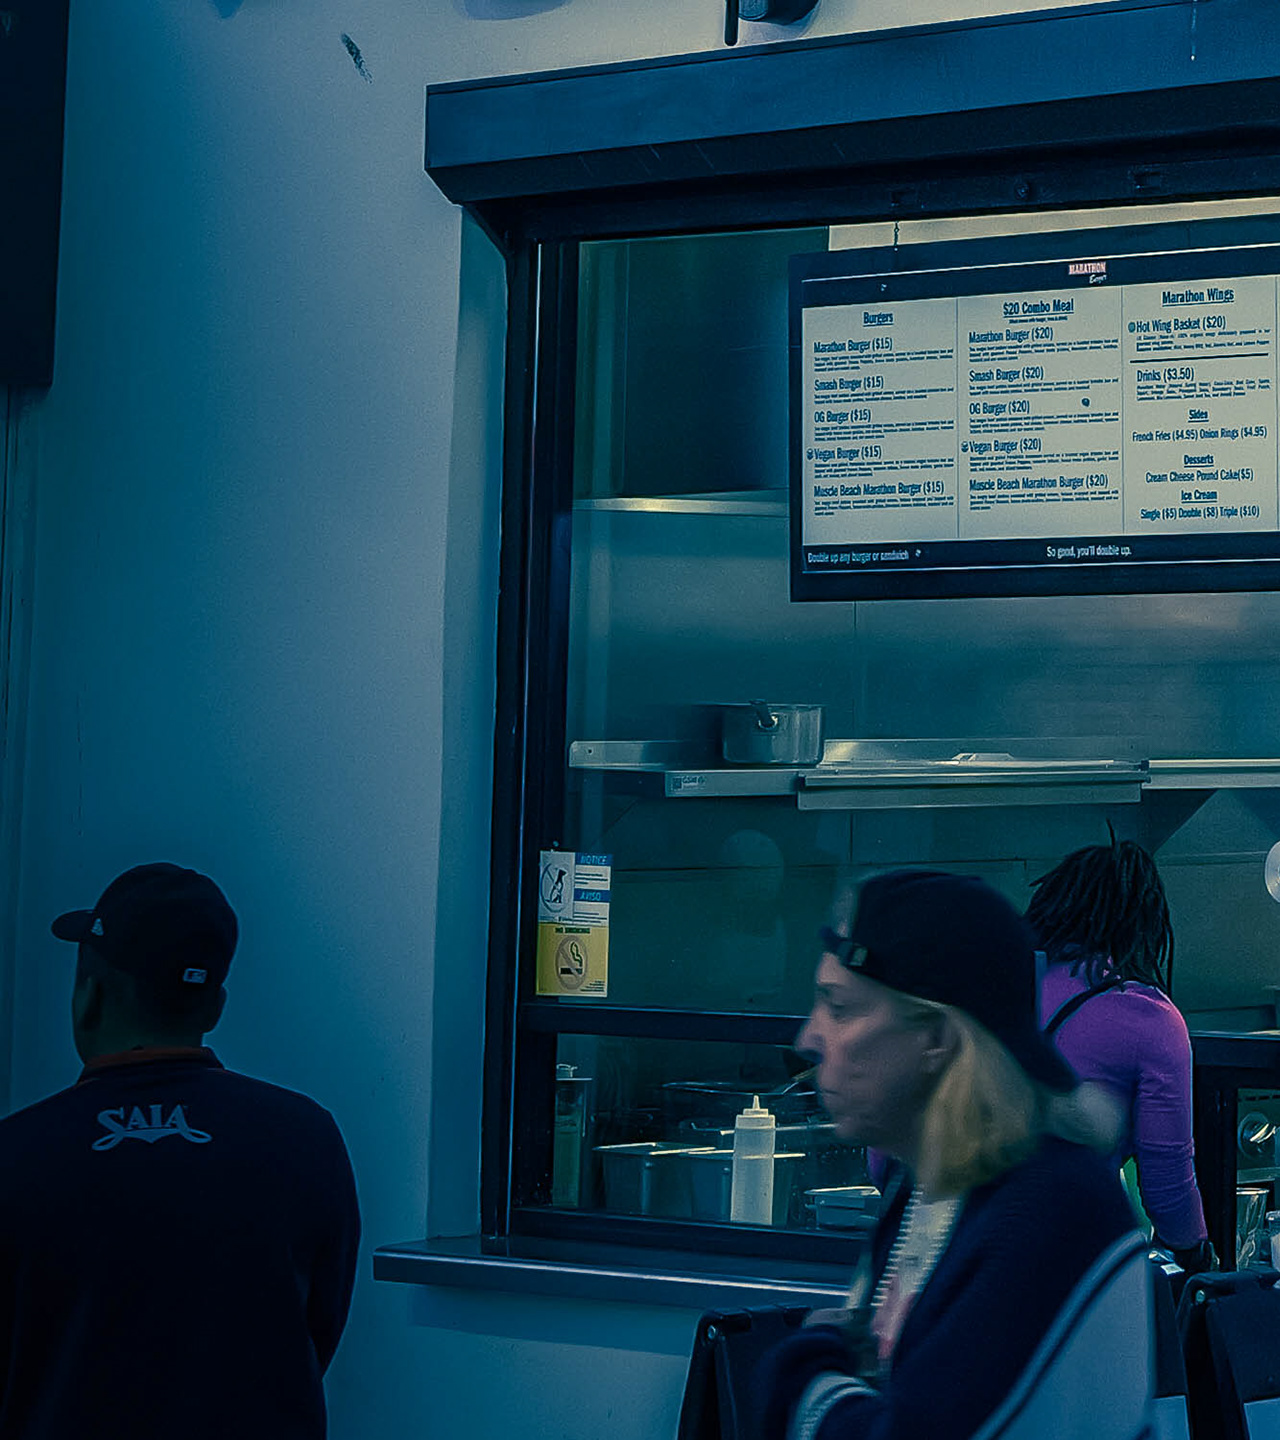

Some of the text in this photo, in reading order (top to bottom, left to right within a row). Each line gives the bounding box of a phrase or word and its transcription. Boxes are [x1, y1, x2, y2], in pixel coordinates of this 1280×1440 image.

[1162, 288, 1234, 303] Marathon Wings
[1003, 298, 1074, 315] $20 Combo Meal
[863, 312, 893, 324] Burgers
[1137, 316, 1226, 333] Hot Wing Basket ($20)
[969, 327, 1053, 343] Marathon Burger ($20)
[814, 337, 893, 353] Marathon Burger ($15)
[969, 367, 1044, 382] Smash Burger ($20)
[1137, 368, 1194, 383] Drinks ($3.50)
[815, 376, 883, 391] Smash Burger ($15)
[970, 400, 1029, 416] OG Burger ($20)
[1189, 410, 1208, 419] Sides
[815, 409, 871, 424] OG Burger ($15)
[1133, 426, 1267, 441] French Fries ($4.95) Onion Rings ($4.95)
[815, 445, 881, 462] Vegan Burger ($15)
[970, 438, 1041, 454] Vegan Burger ($20)
[1184, 455, 1214, 465] Desserts
[970, 474, 1108, 491] Muscle Beach Marathon Burger ($20)
[1146, 472, 1167, 483] Cream
[1170, 471, 1194, 482] Cheese
[1197, 470, 1218, 481] Pound
[814, 481, 944, 497] Muscle Beach Marathon Burger ($15)
[1181, 490, 1217, 500] Ice Cream
[1141, 506, 1259, 521] Single ($5) Double ($8) Triple ($10)
[1047, 545, 1131, 559] So good, you'll double up.
[581, 855, 607, 864] NOTICE
